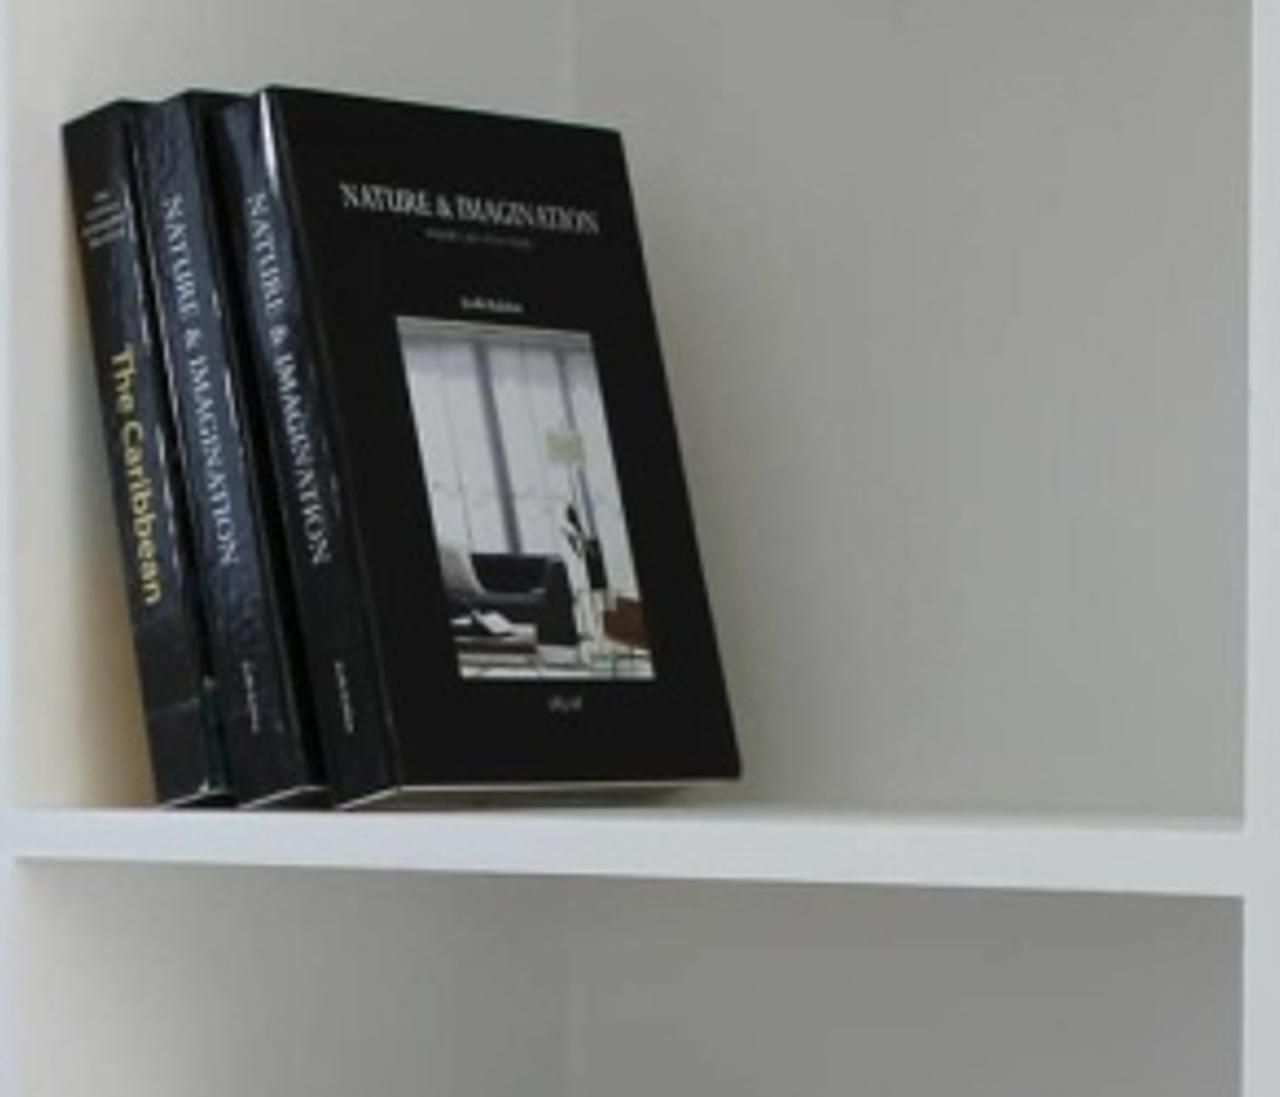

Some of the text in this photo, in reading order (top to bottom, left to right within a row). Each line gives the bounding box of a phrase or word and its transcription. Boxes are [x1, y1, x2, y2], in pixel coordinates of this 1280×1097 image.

[339, 181, 601, 235] NATURE & IMAGINATION
[111, 348, 163, 605] The Caribbean
[162, 193, 240, 570] NATURE & IMAGINATION
[248, 193, 333, 569] NATURE & IMAGINATION
